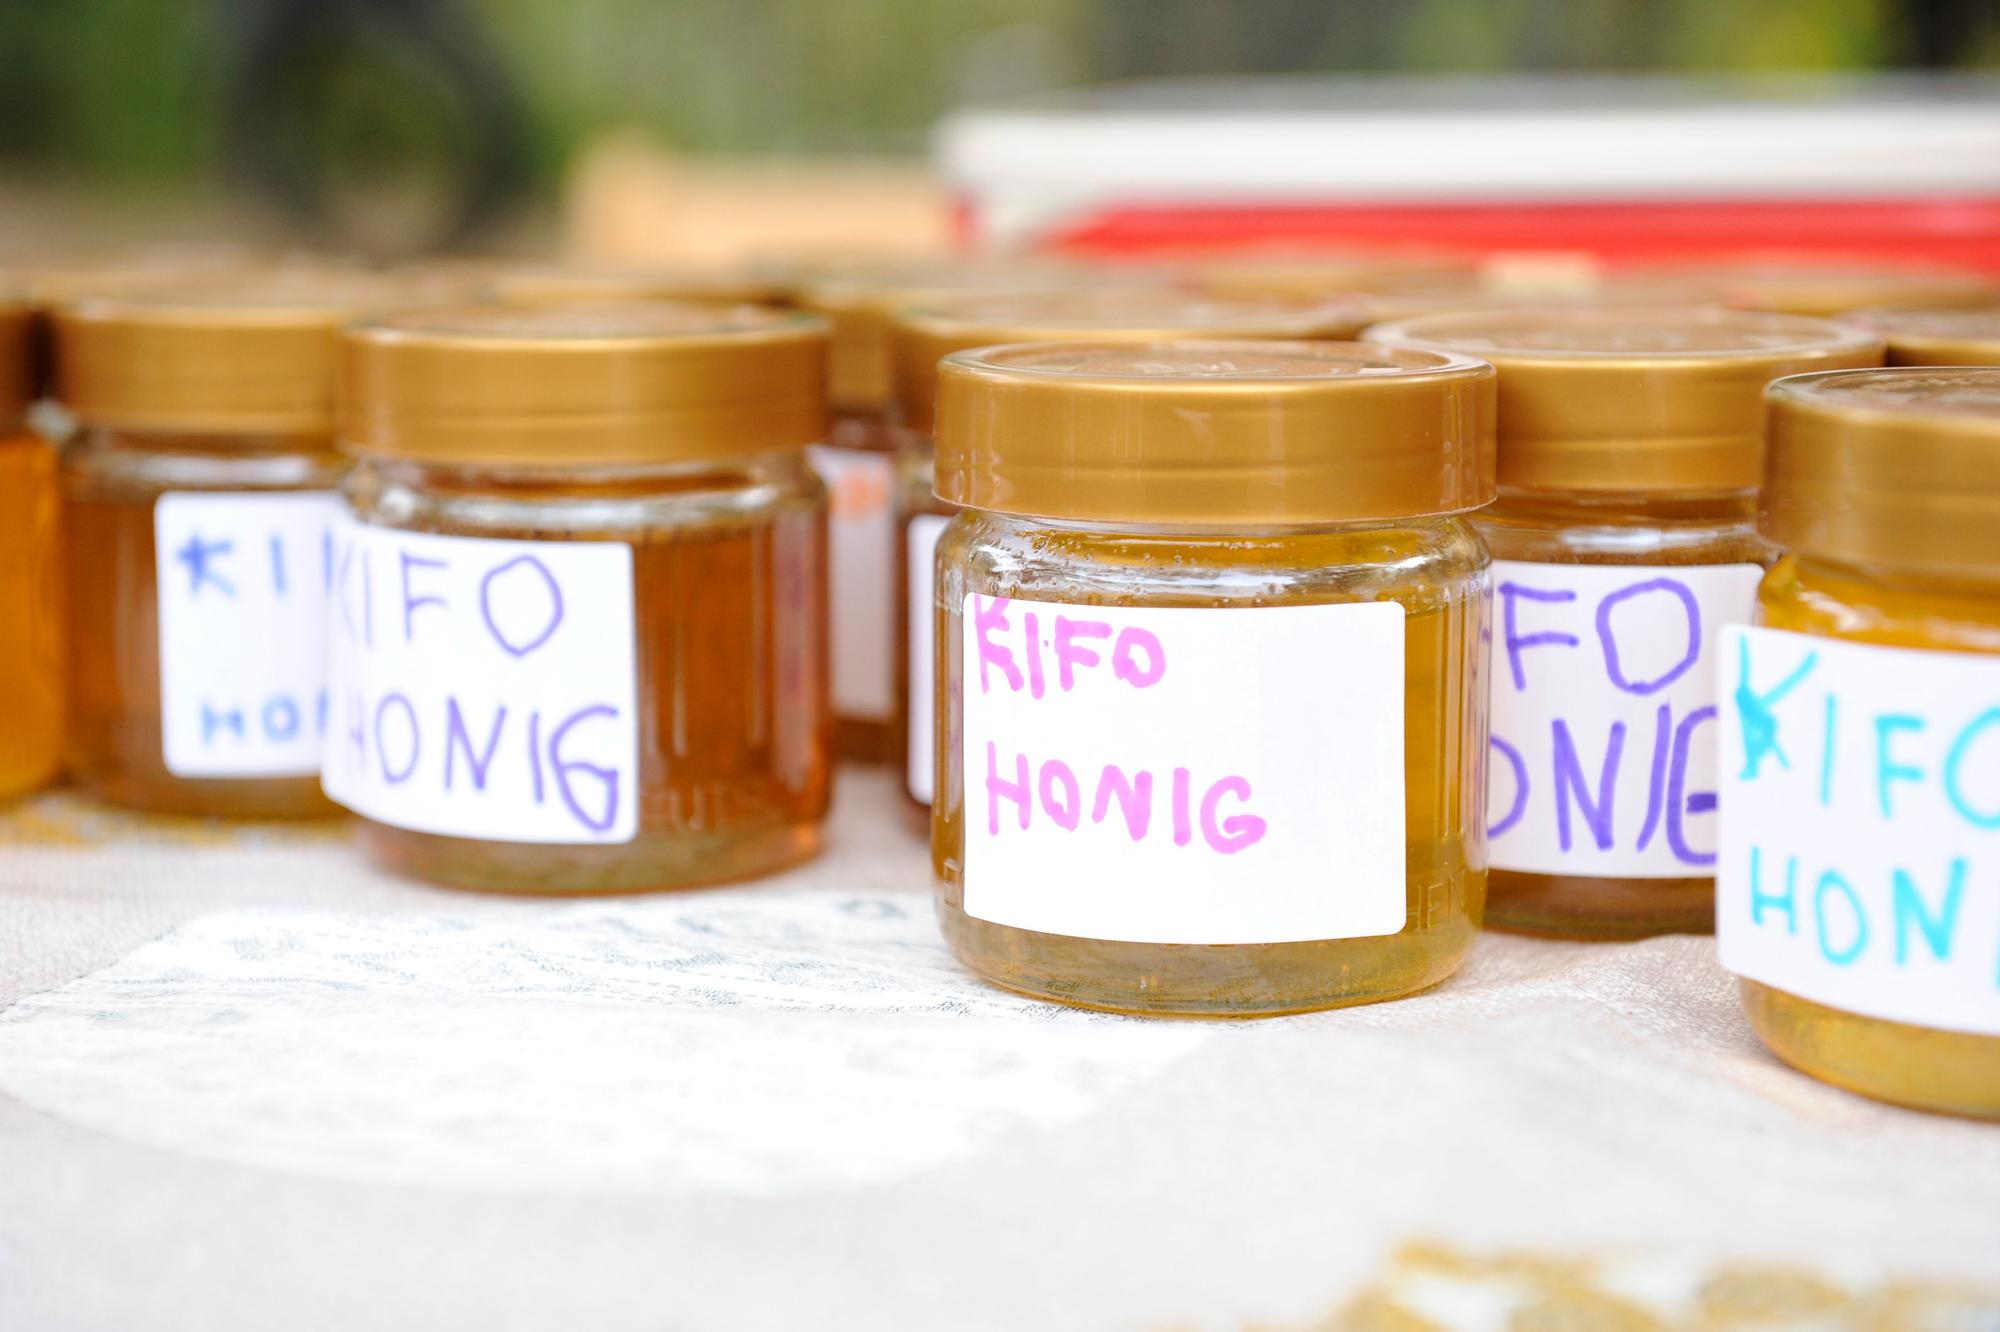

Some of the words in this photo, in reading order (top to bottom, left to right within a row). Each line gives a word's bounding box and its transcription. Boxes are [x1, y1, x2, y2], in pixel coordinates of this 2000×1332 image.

[974, 593, 1167, 700] KIFO
[1498, 578, 1701, 695] FO
[1735, 634, 2000, 830] KIFO
[986, 740, 1267, 855] HONIG
[1751, 845, 2000, 992] HON
